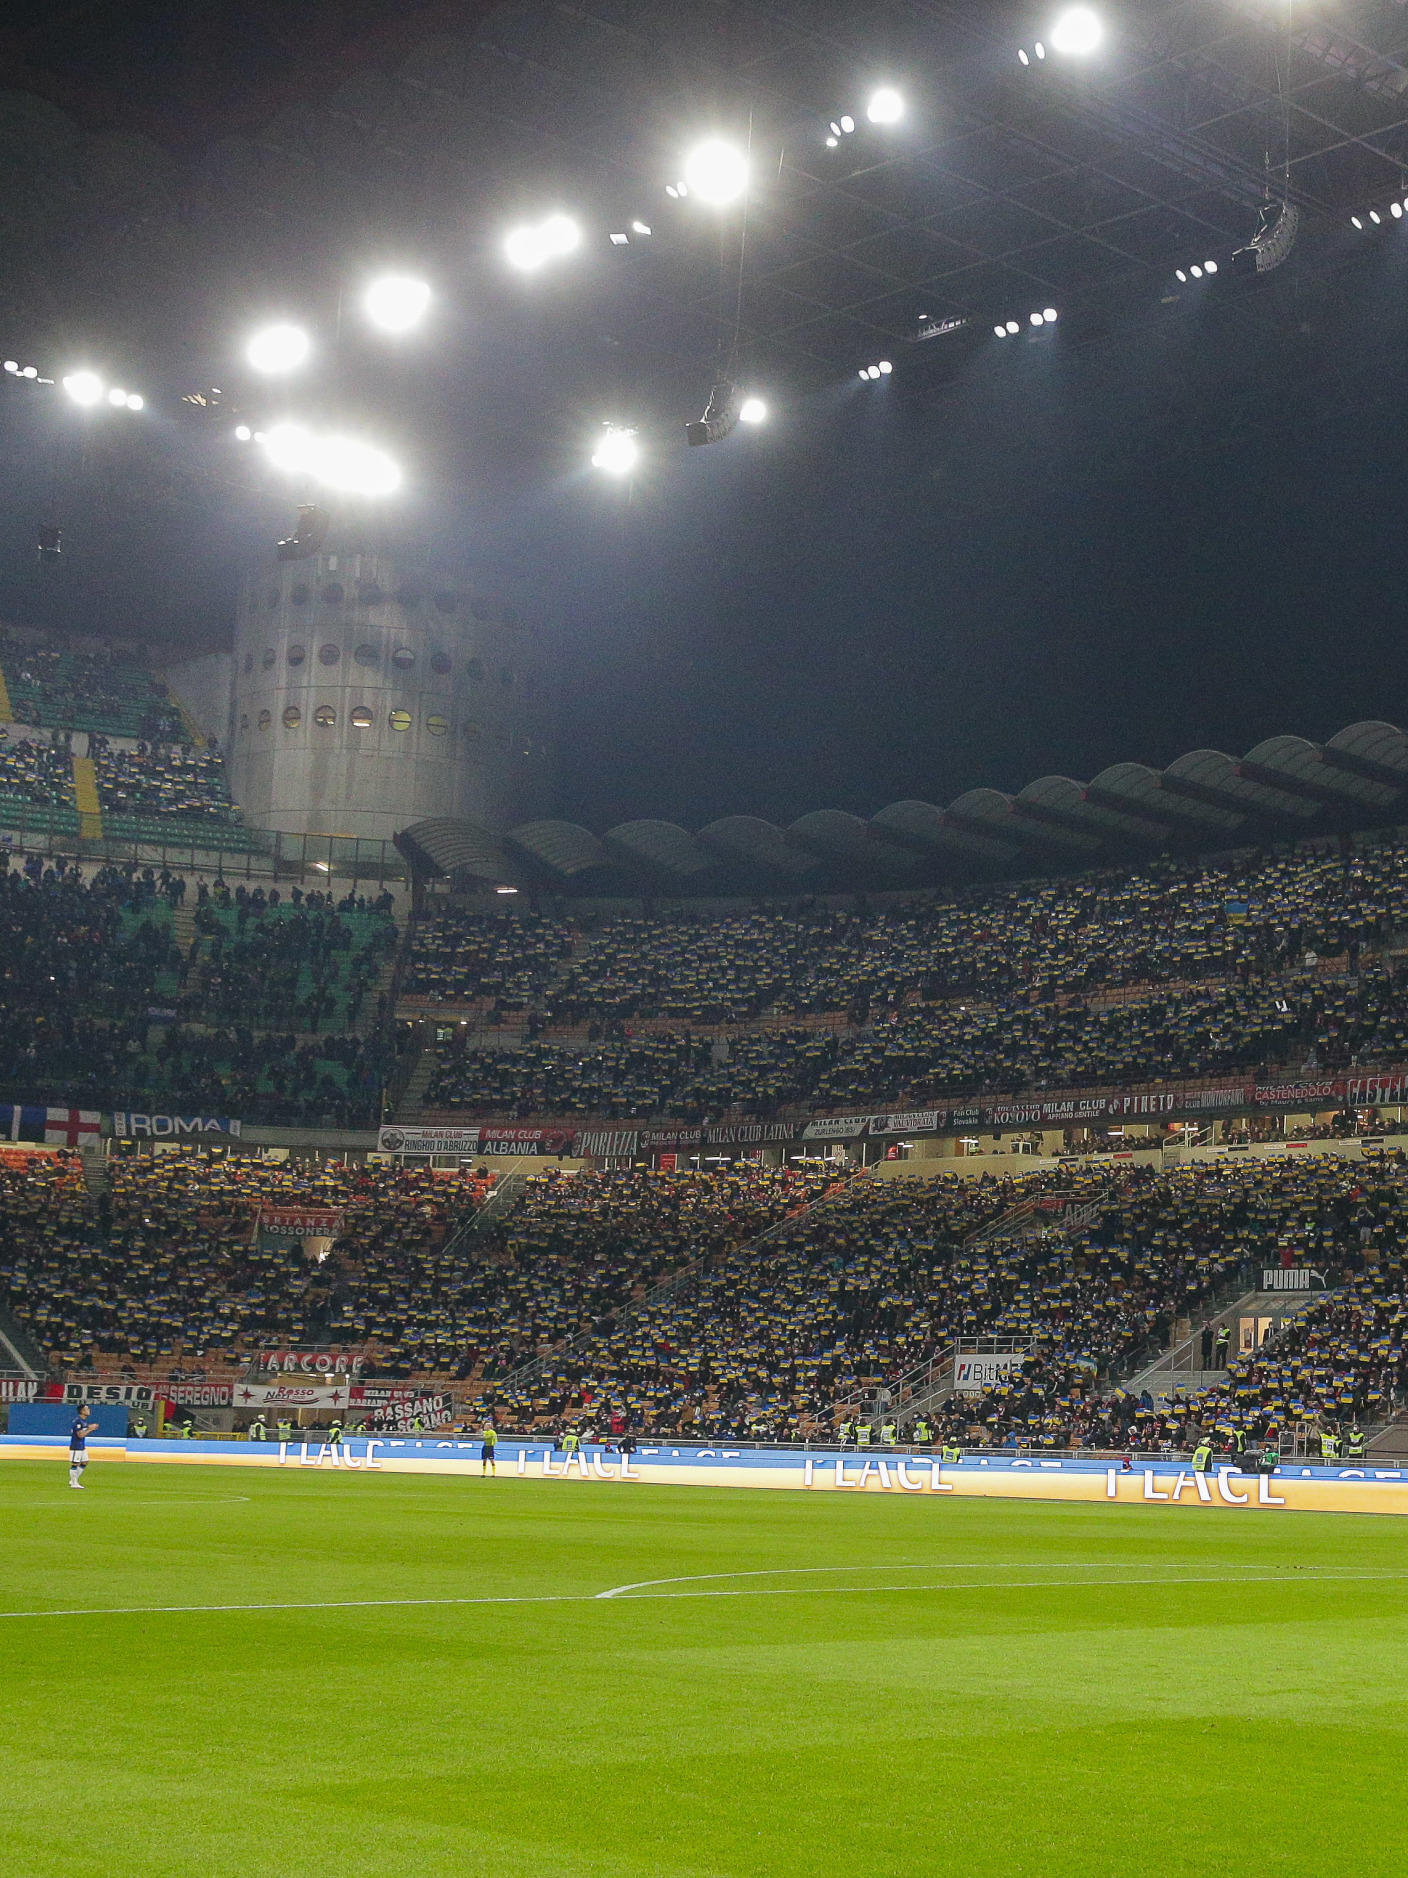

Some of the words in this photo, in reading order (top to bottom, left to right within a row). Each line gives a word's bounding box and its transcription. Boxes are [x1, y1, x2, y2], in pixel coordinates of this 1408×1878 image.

[1255, 1087, 1331, 1101] CASTENEDOLO
[1042, 1101, 1075, 1114] MILAN
[1079, 1099, 1106, 1111] CLUB
[1123, 1094, 1174, 1114] PINETO
[130, 1113, 223, 1137] ROMA
[485, 1130, 516, 1139] MILAN
[517, 1130, 542, 1139] CLUB
[651, 1131, 678, 1141] MILAN
[679, 1130, 701, 1140] CLUB
[707, 1128, 735, 1144] MILAN
[738, 1125, 763, 1143] CLUB
[764, 1123, 794, 1140] LATINA
[404, 1139, 435, 1151] RINGHIO
[483, 1141, 538, 1155] ALBANIA
[1263, 1269, 1310, 1289] PUMA
[67, 1384, 152, 1401] DESIO
[170, 1385, 228, 1405] SEREGNO
[278, 1386, 314, 1396] Rosso
[374, 1396, 443, 1422] BASSANO
